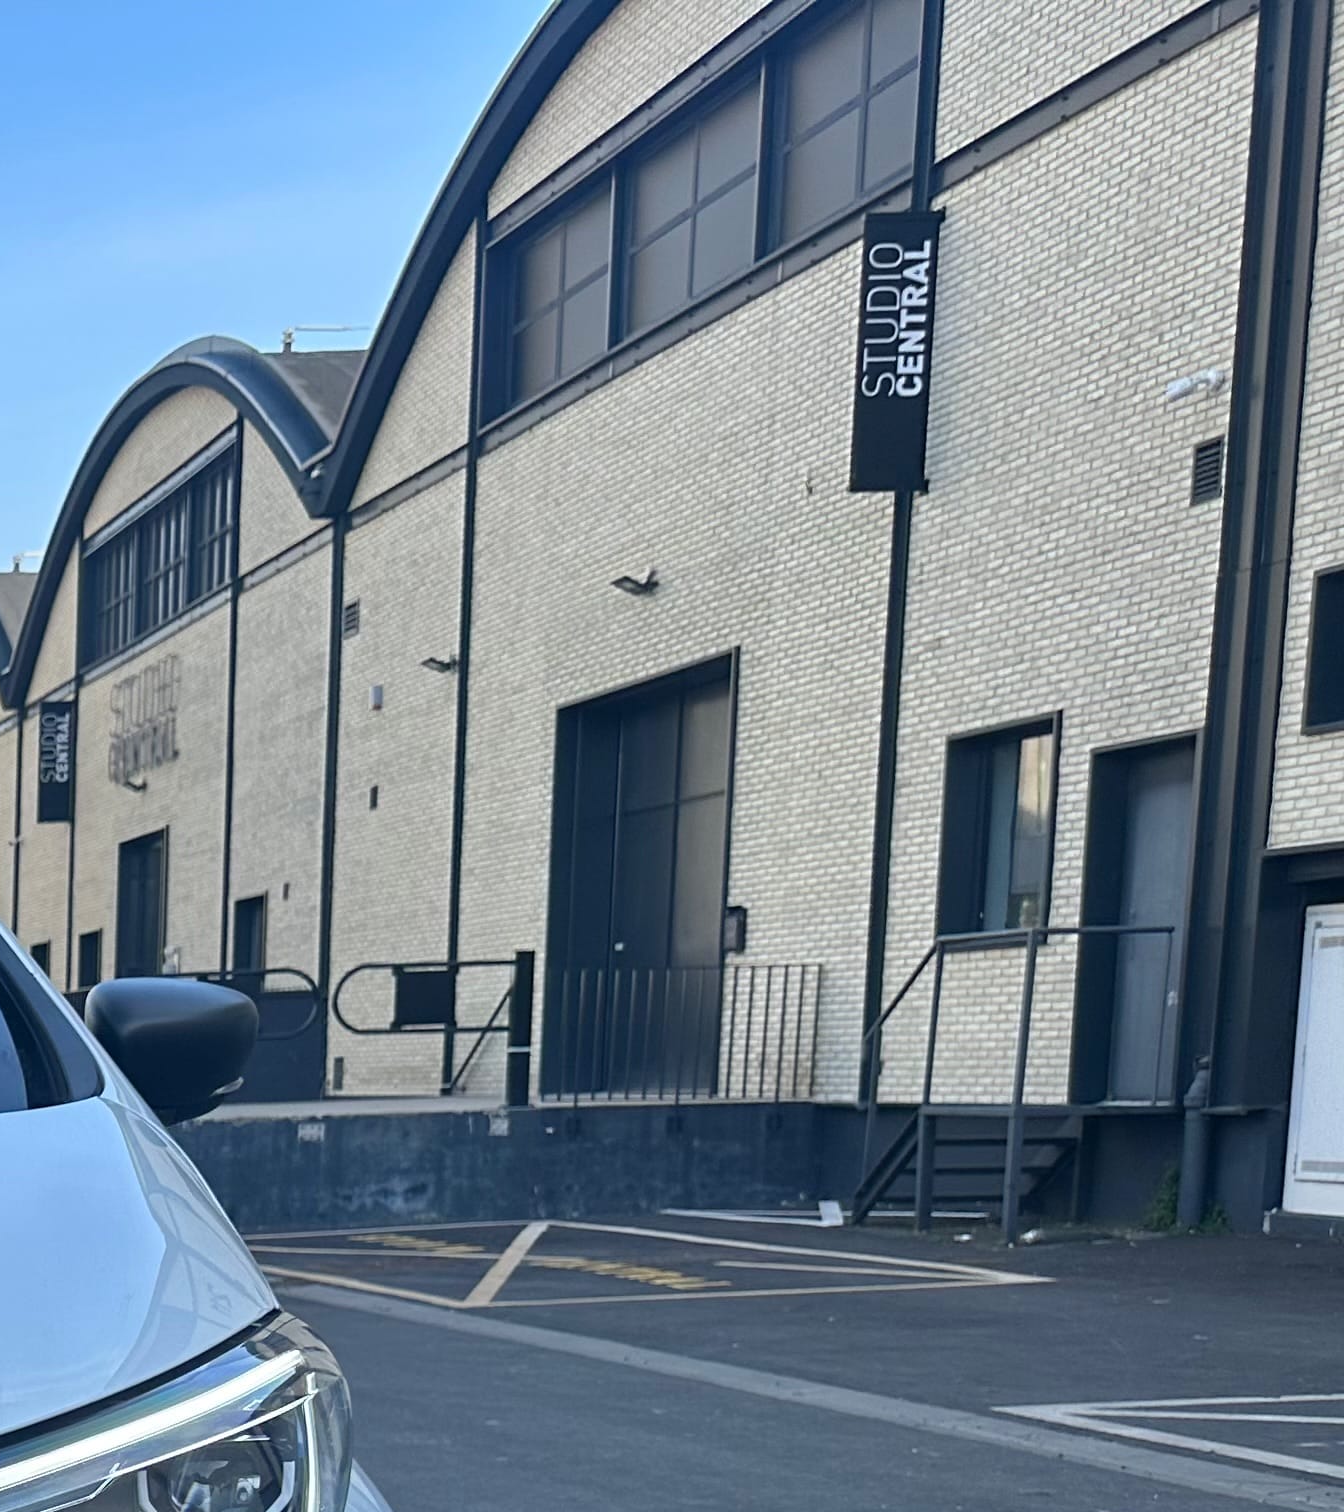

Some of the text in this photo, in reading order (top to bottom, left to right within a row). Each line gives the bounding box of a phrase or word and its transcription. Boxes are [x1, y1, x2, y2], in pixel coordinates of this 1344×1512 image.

[861, 242, 904, 398] STUDIO
[896, 240, 932, 398] CENTRAL
[40, 712, 57, 783] STUDIO
[55, 712, 70, 783] CENTRAL
